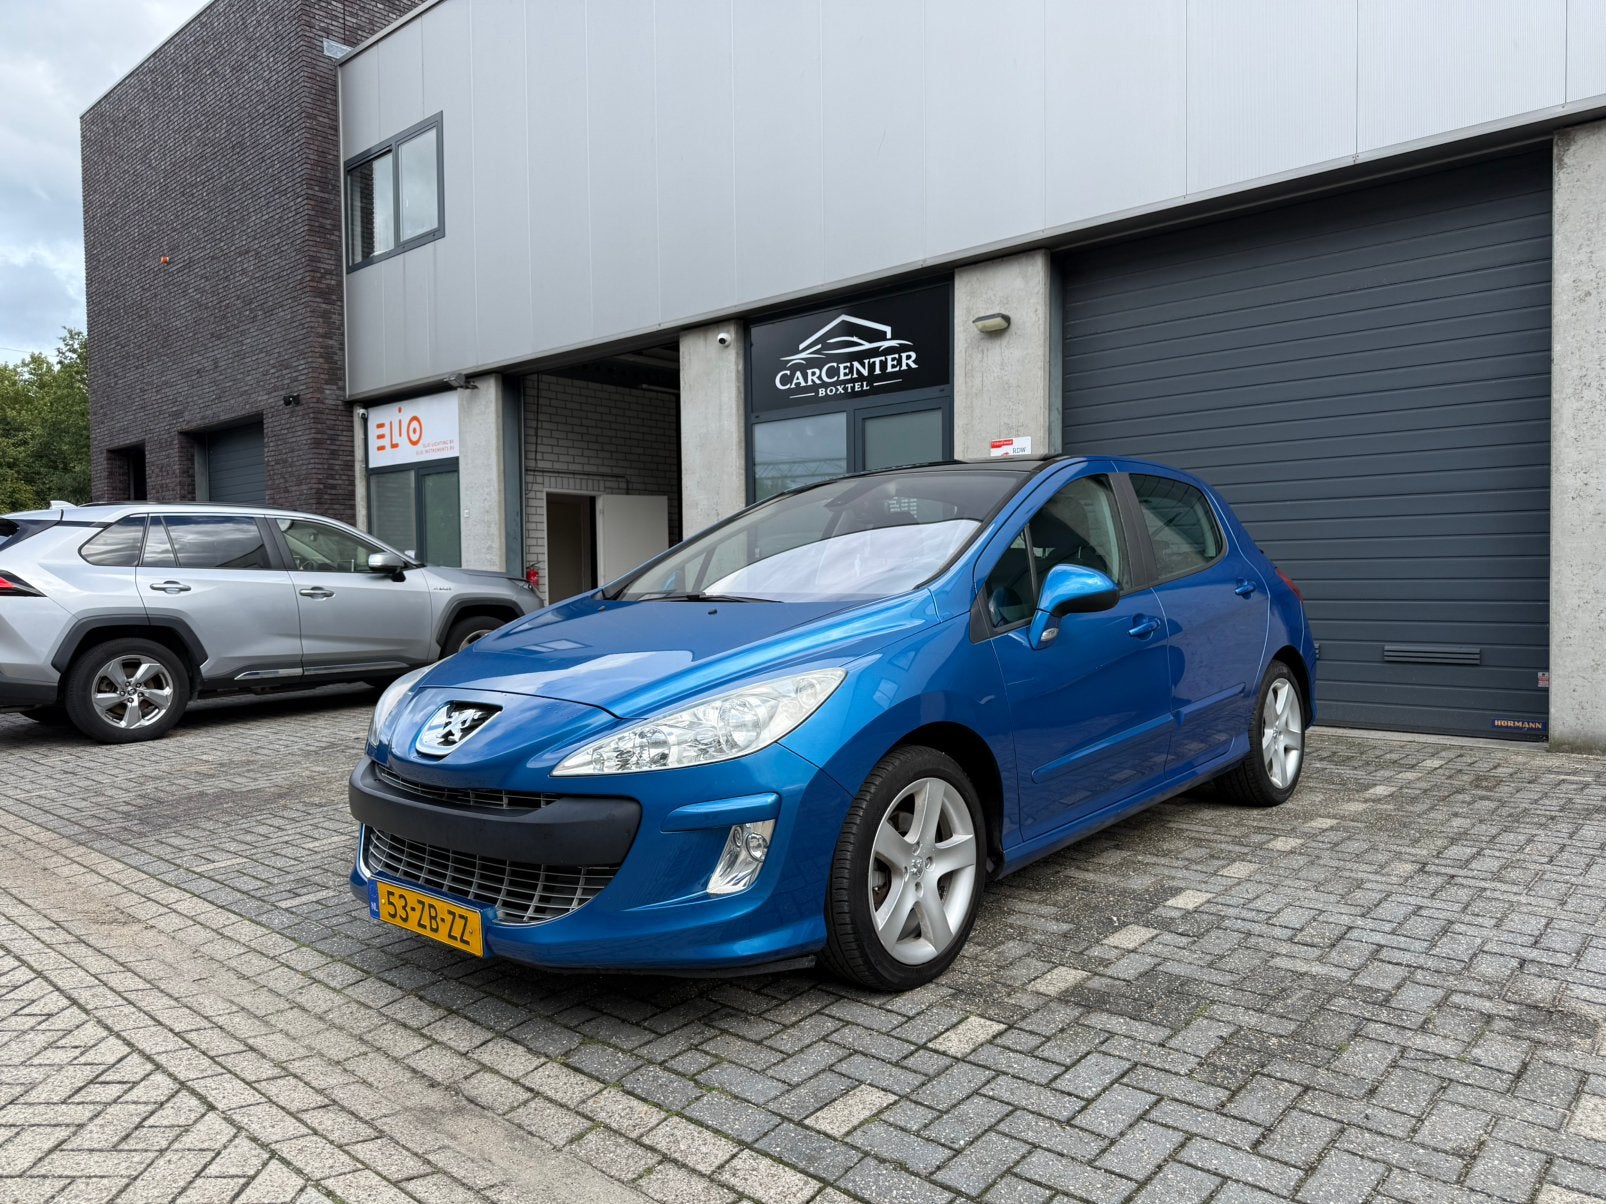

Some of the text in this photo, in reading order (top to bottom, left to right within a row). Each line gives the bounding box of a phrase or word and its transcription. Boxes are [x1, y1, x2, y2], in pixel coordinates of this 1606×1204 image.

[818, 381, 870, 397] BOXTEL
[1012, 446, 1027, 454] RDW
[370, 901, 379, 912] NL
[386, 889, 471, 947] 53-ZB-ZZ
